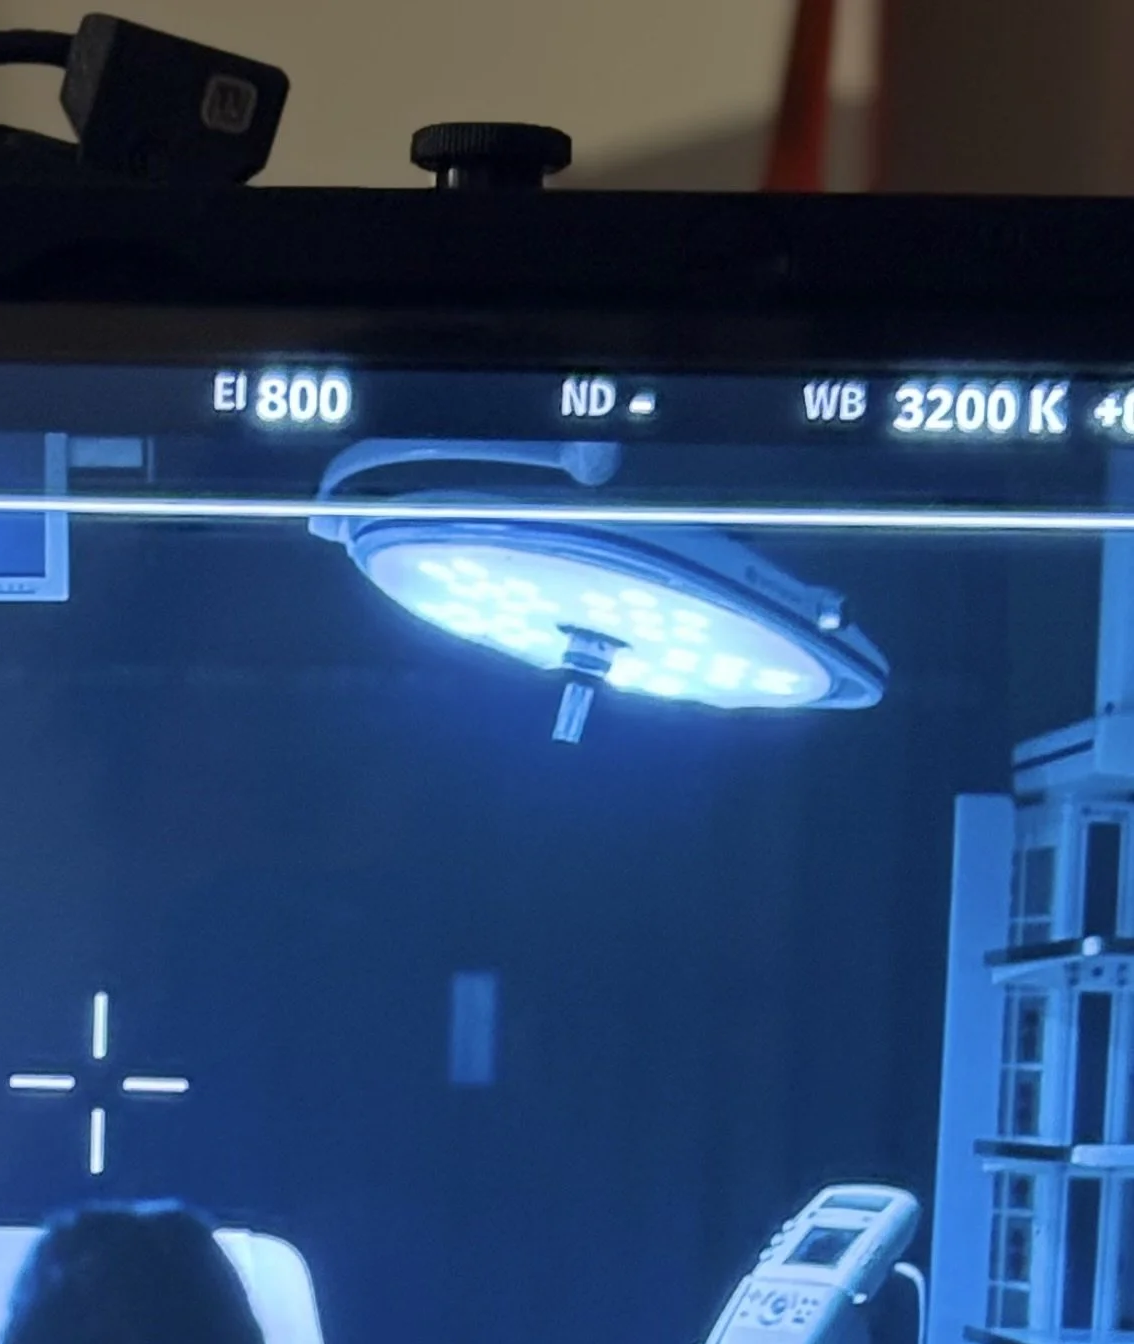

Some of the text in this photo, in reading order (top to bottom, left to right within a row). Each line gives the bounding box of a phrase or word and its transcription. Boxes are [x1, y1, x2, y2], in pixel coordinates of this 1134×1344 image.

[213, 373, 350, 422] EI 800
[561, 379, 616, 416] ND
[802, 382, 867, 421] WB
[892, 383, 1018, 432] 3200
[1028, 382, 1070, 433] K
